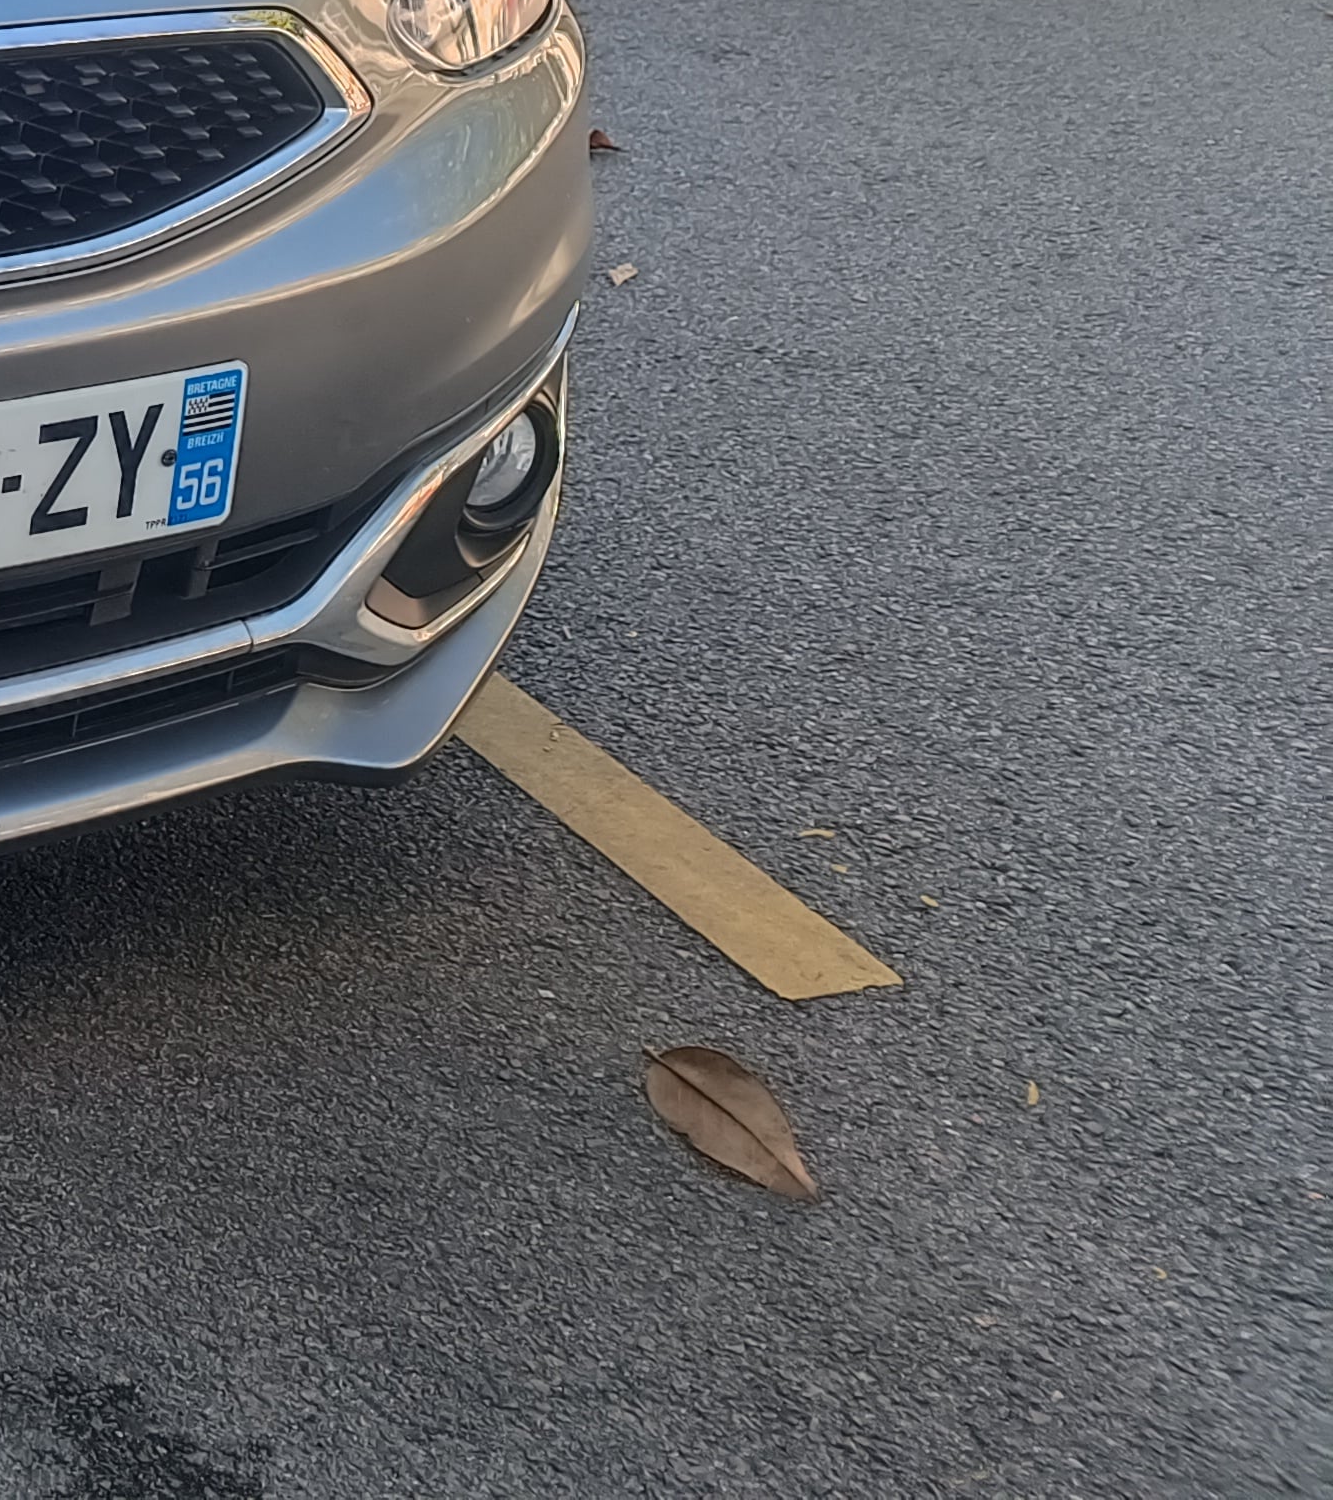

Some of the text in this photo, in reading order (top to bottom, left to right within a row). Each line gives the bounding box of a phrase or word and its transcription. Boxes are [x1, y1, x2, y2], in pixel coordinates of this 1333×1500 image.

[187, 375, 237, 395] BRETAGNE
[186, 431, 224, 449] BREIZH
[176, 458, 224, 510] 56
